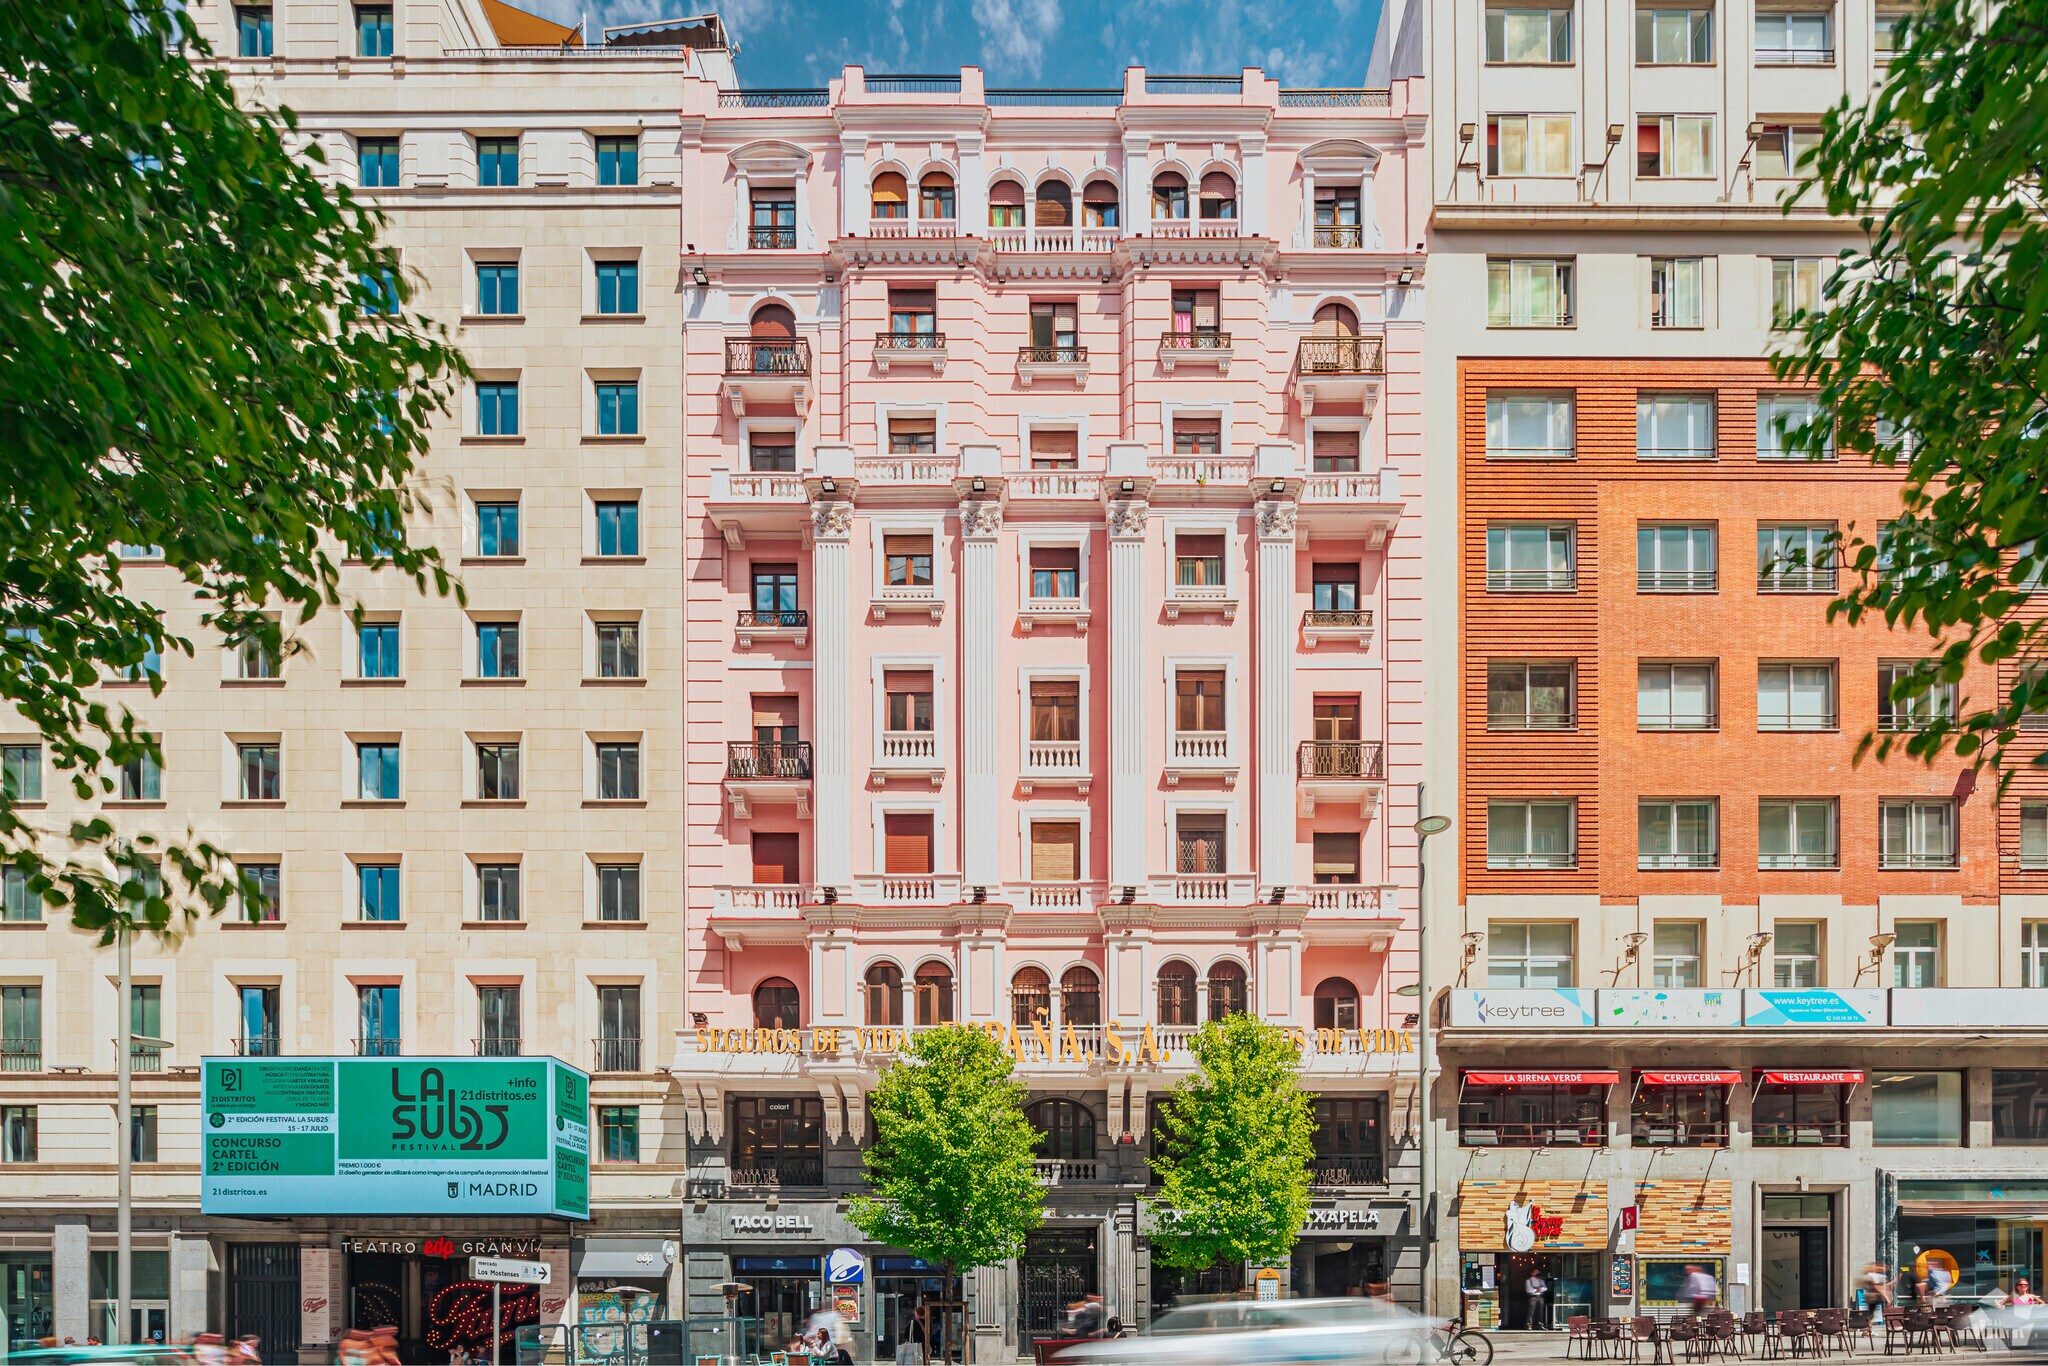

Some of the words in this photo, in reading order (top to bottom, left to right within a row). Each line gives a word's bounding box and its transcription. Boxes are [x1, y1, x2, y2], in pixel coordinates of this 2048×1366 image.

[1774, 997, 1839, 1006] www.keytree.es
[1485, 1003, 1565, 1020] keytree
[696, 1027, 801, 1053] SEGUROS
[812, 1027, 843, 1053] DE
[855, 1028, 910, 1053] VIDA
[938, 1007, 1094, 1067] PAÑA,
[1105, 1020, 1171, 1063] S.A.
[1316, 1027, 1346, 1053] DE
[1358, 1028, 1415, 1053] VIDA
[507, 1077, 537, 1088] +info
[1664, 1072, 1721, 1082] CERVECERÍA
[1783, 1074, 1844, 1082] RESTAURANTE
[460, 1090, 537, 1100] 21distritos.es
[212, 1138, 282, 1148] CONCURSO
[212, 1150, 258, 1159] CARTEL
[558, 1152, 585, 1166] CONCURSO
[212, 1162, 224, 1171] 2ª
[228, 1160, 279, 1171] EDICIÓN
[558, 1161, 576, 1172] CARTEL
[564, 1172, 584, 1183] EDICIÓN
[213, 1188, 267, 1196] 21distritos.es
[470, 1184, 538, 1196] MADRID
[732, 1216, 772, 1229] TACO
[775, 1216, 813, 1229] BELL
[341, 1242, 416, 1253] TEATRO
[423, 1236, 454, 1259] edp
[636, 1252, 653, 1263] edp
